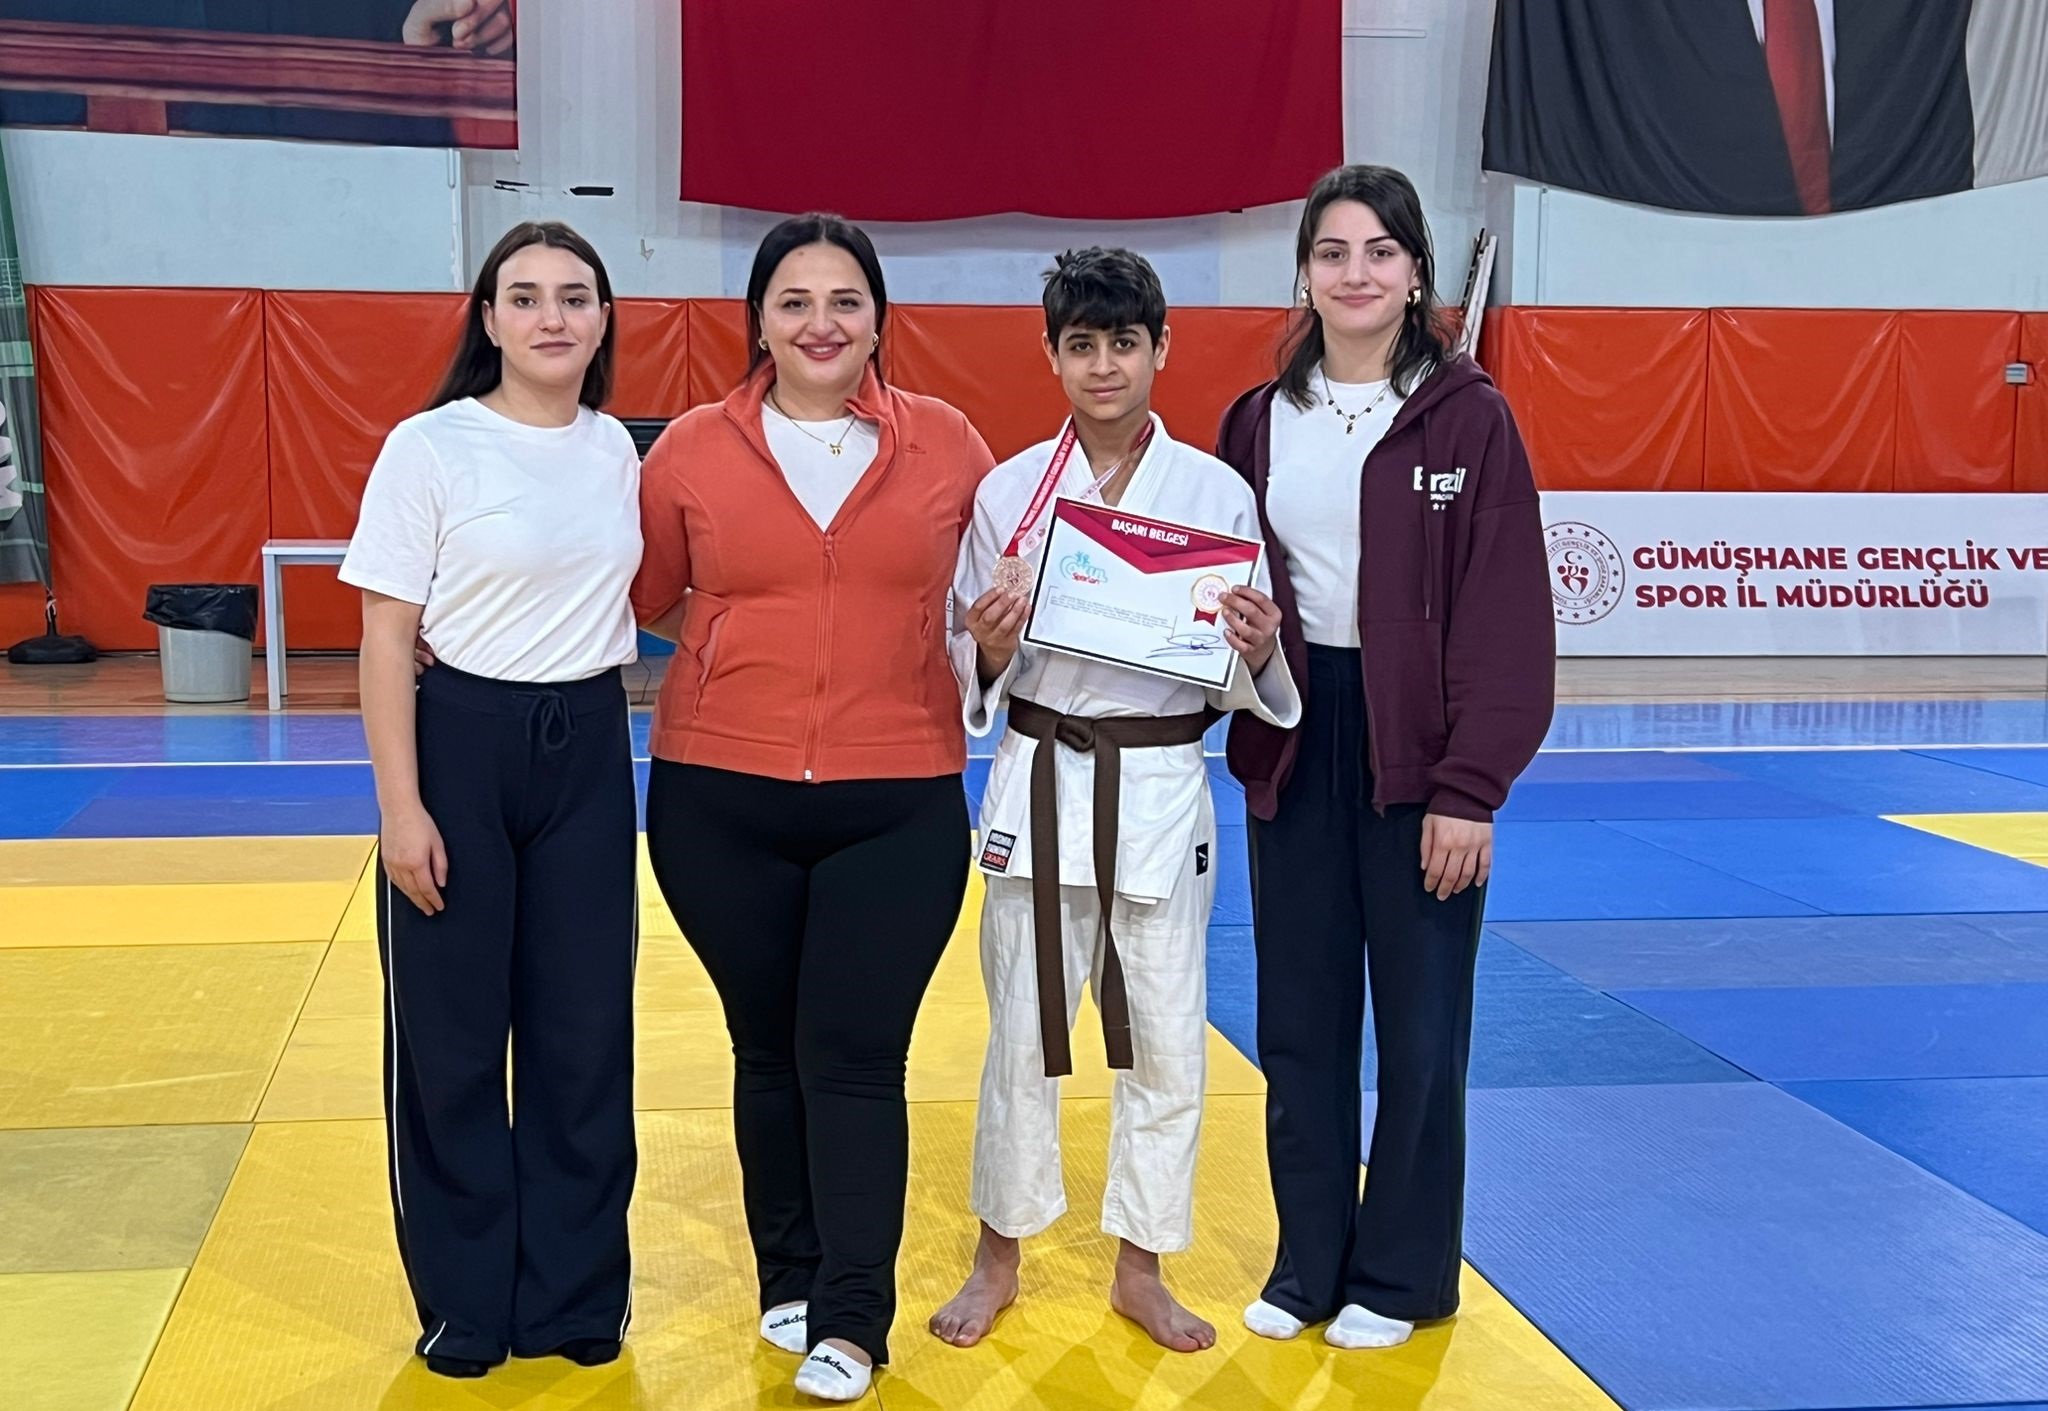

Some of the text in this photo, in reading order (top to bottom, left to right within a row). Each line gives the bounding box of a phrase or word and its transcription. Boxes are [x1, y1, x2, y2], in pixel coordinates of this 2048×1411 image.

[1111, 519, 1189, 546] BAŞARI BELGESİ
[1632, 539, 2048, 577] GÜMÜŞHANE GENÇLİK VE
[1635, 577, 1989, 608] SPOR İL MÜDÜRLÜĞÜ
